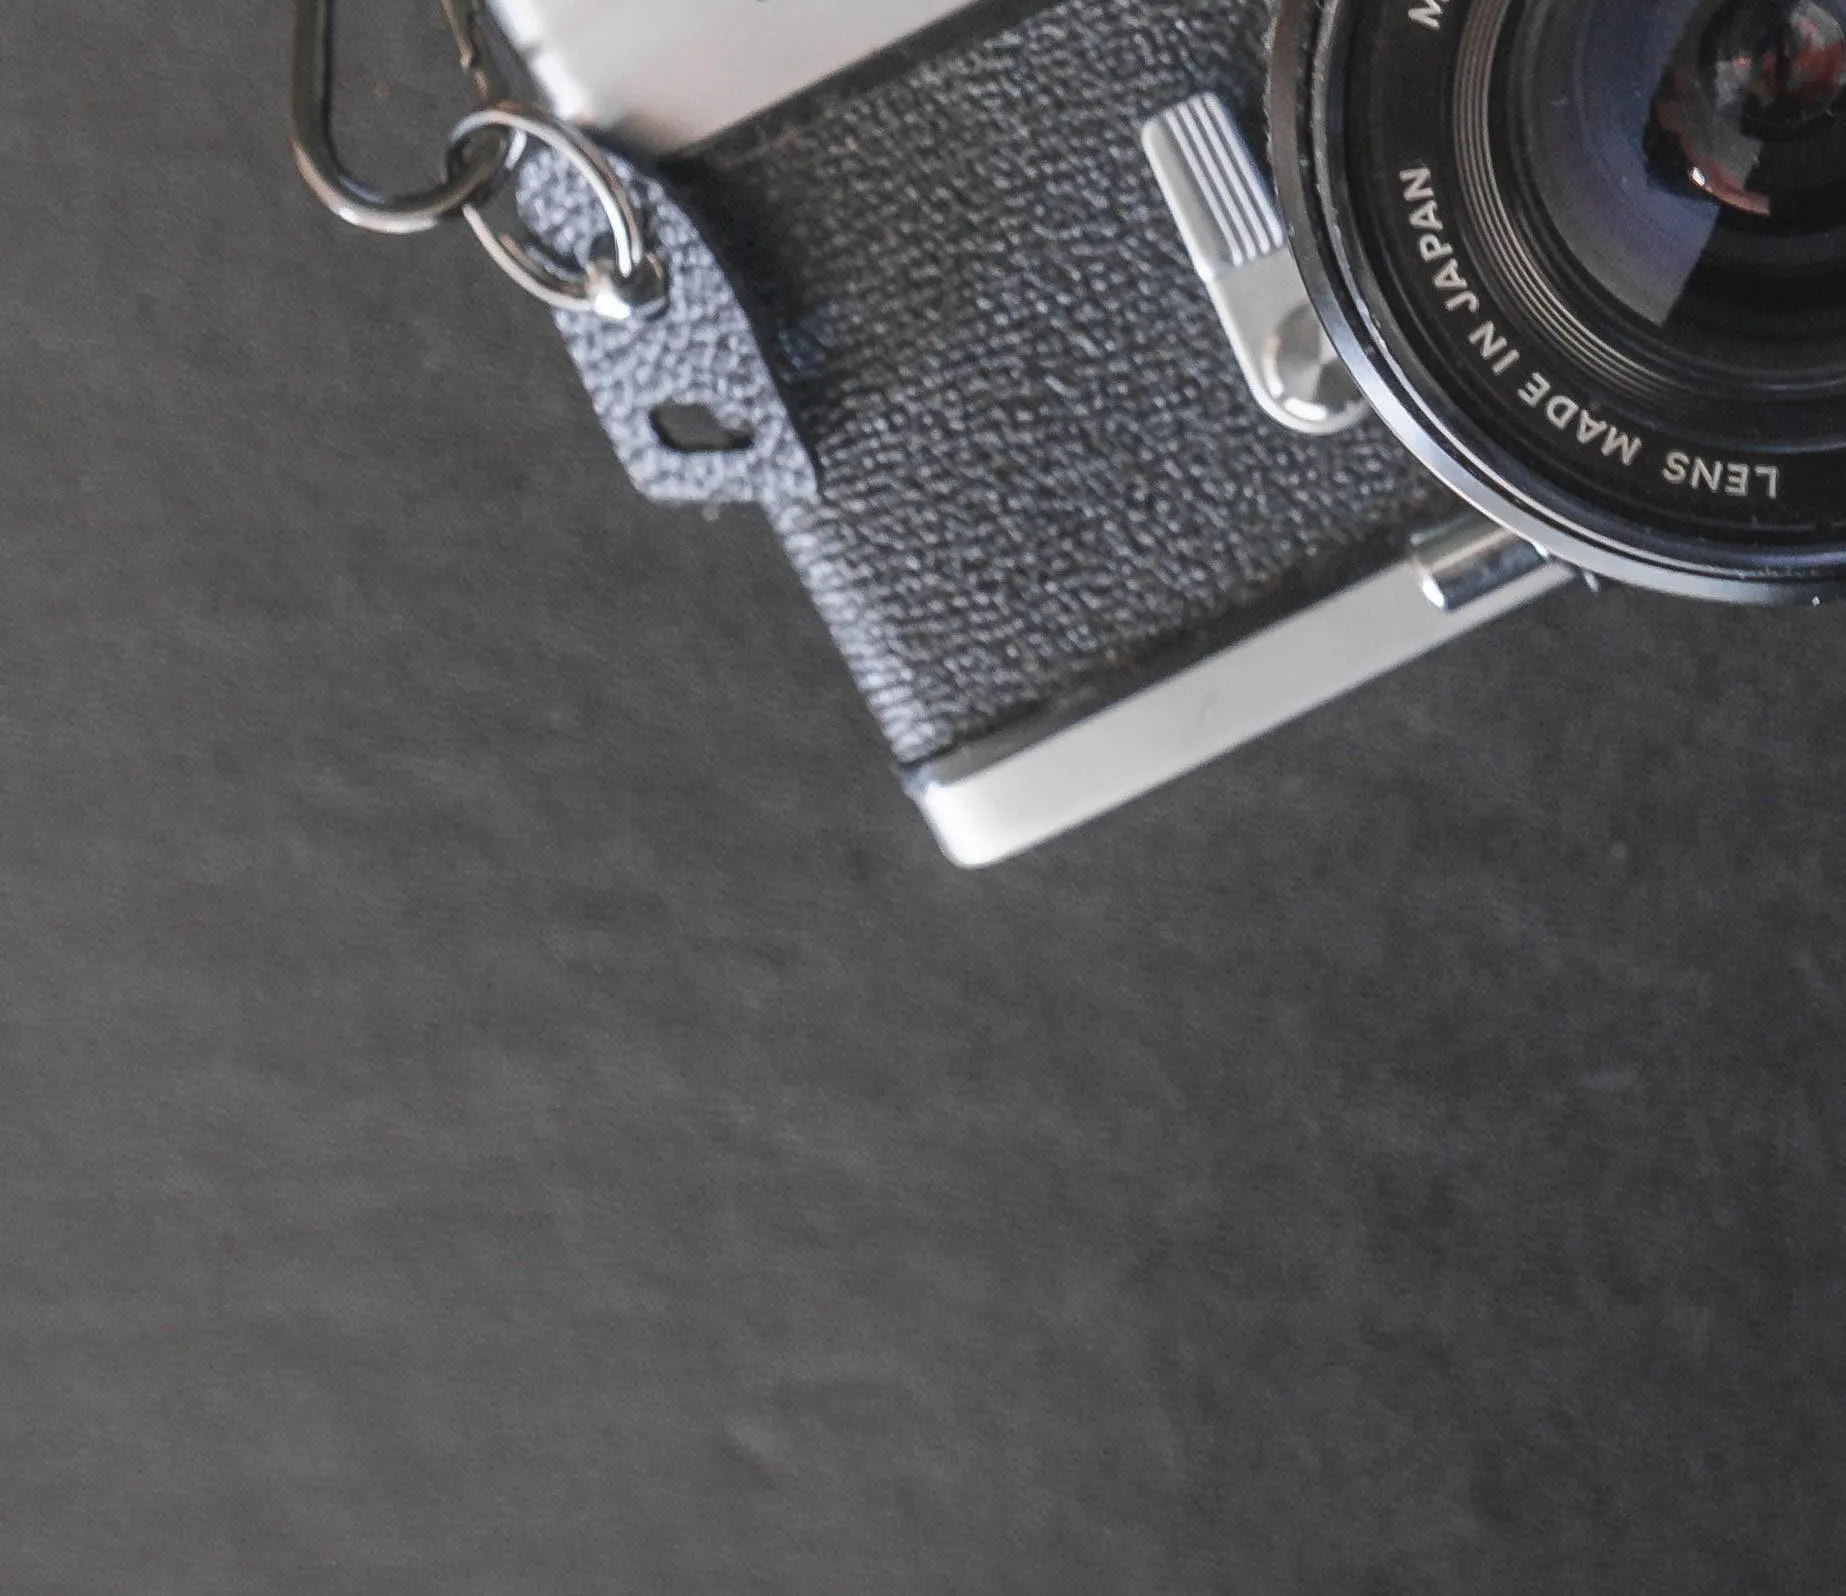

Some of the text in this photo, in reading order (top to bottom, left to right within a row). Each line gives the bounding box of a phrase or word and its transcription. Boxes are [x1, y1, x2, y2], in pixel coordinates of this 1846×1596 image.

[1399, 165, 1480, 312] JAPAN
[1467, 320, 1521, 376] IN
[1517, 371, 1643, 467] MADE
[1661, 449, 1780, 500] LENS
